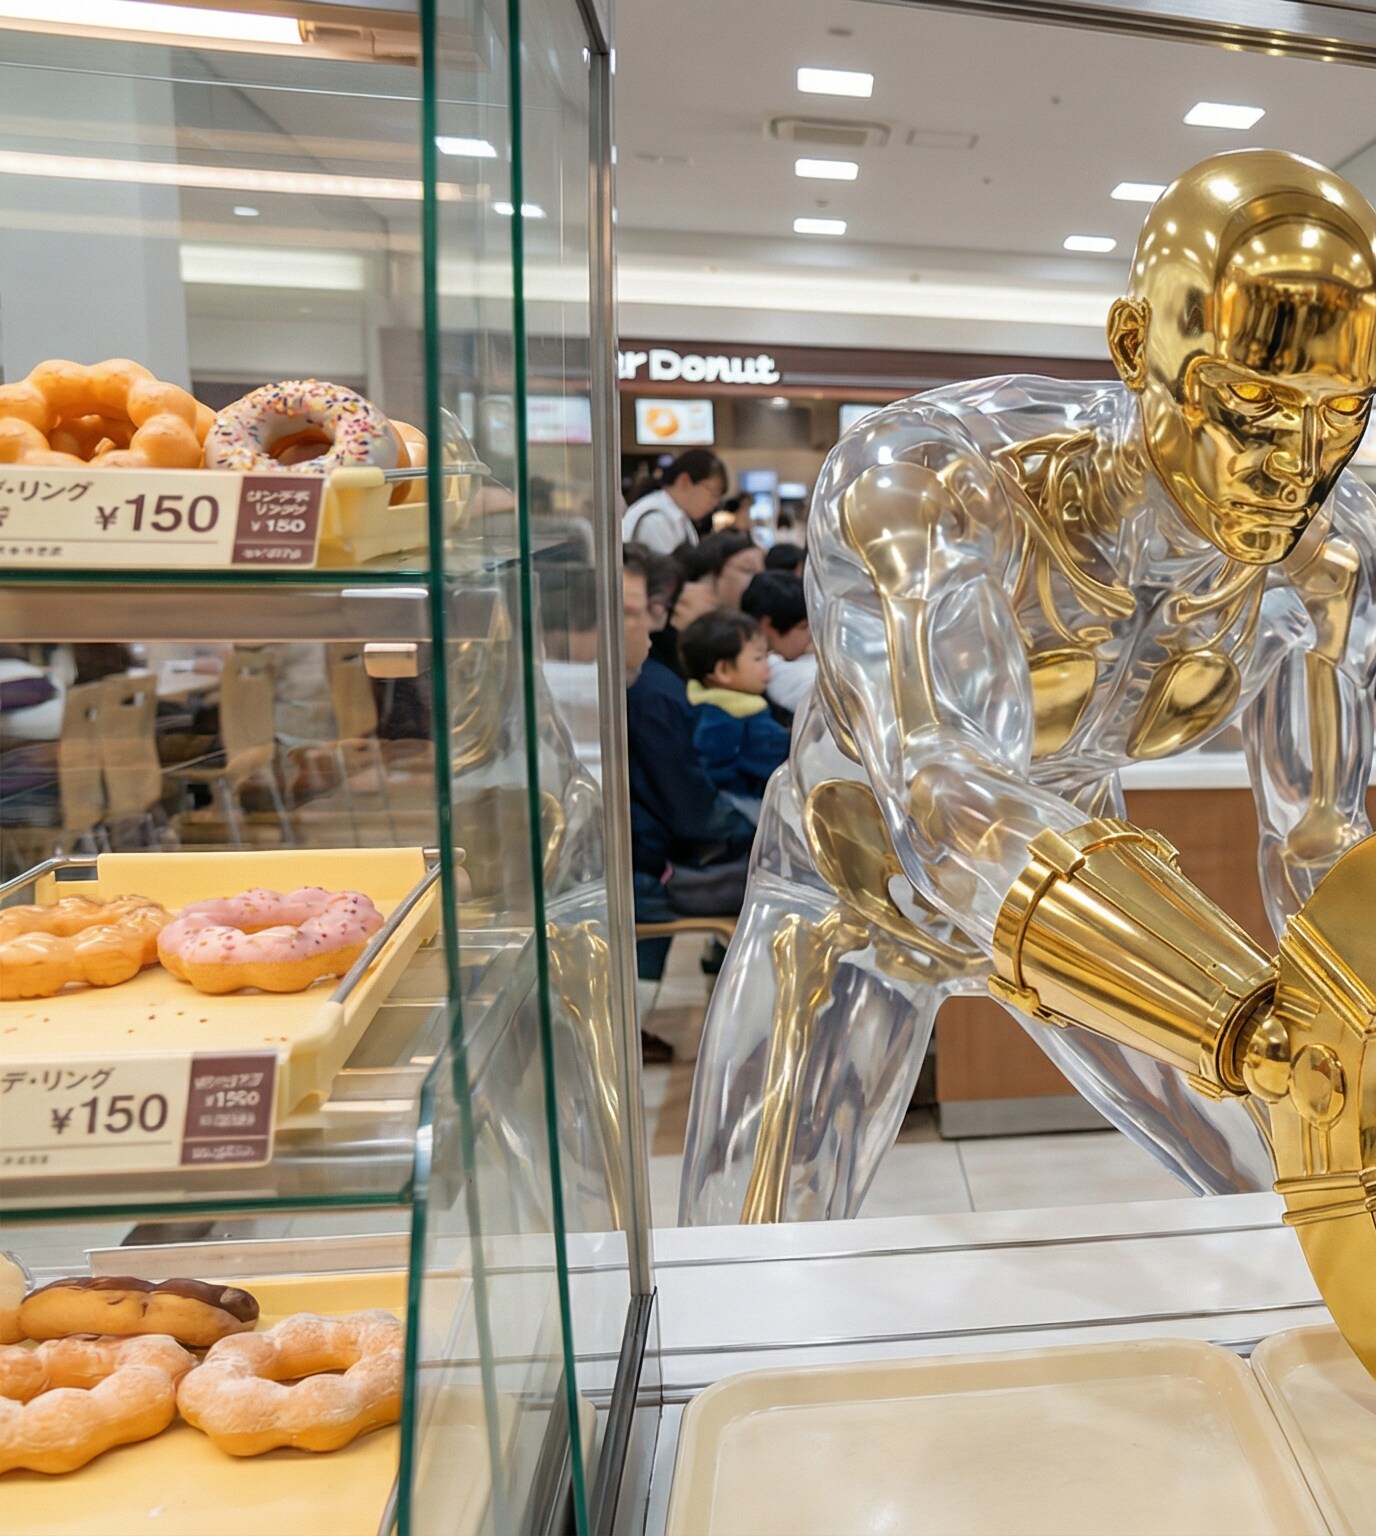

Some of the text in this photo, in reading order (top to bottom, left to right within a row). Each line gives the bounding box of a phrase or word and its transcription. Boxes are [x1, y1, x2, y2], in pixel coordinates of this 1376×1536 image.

[649, 349, 780, 384] Donut
[95, 494, 220, 533] ¥150
[51, 1094, 168, 1135] ¥150
